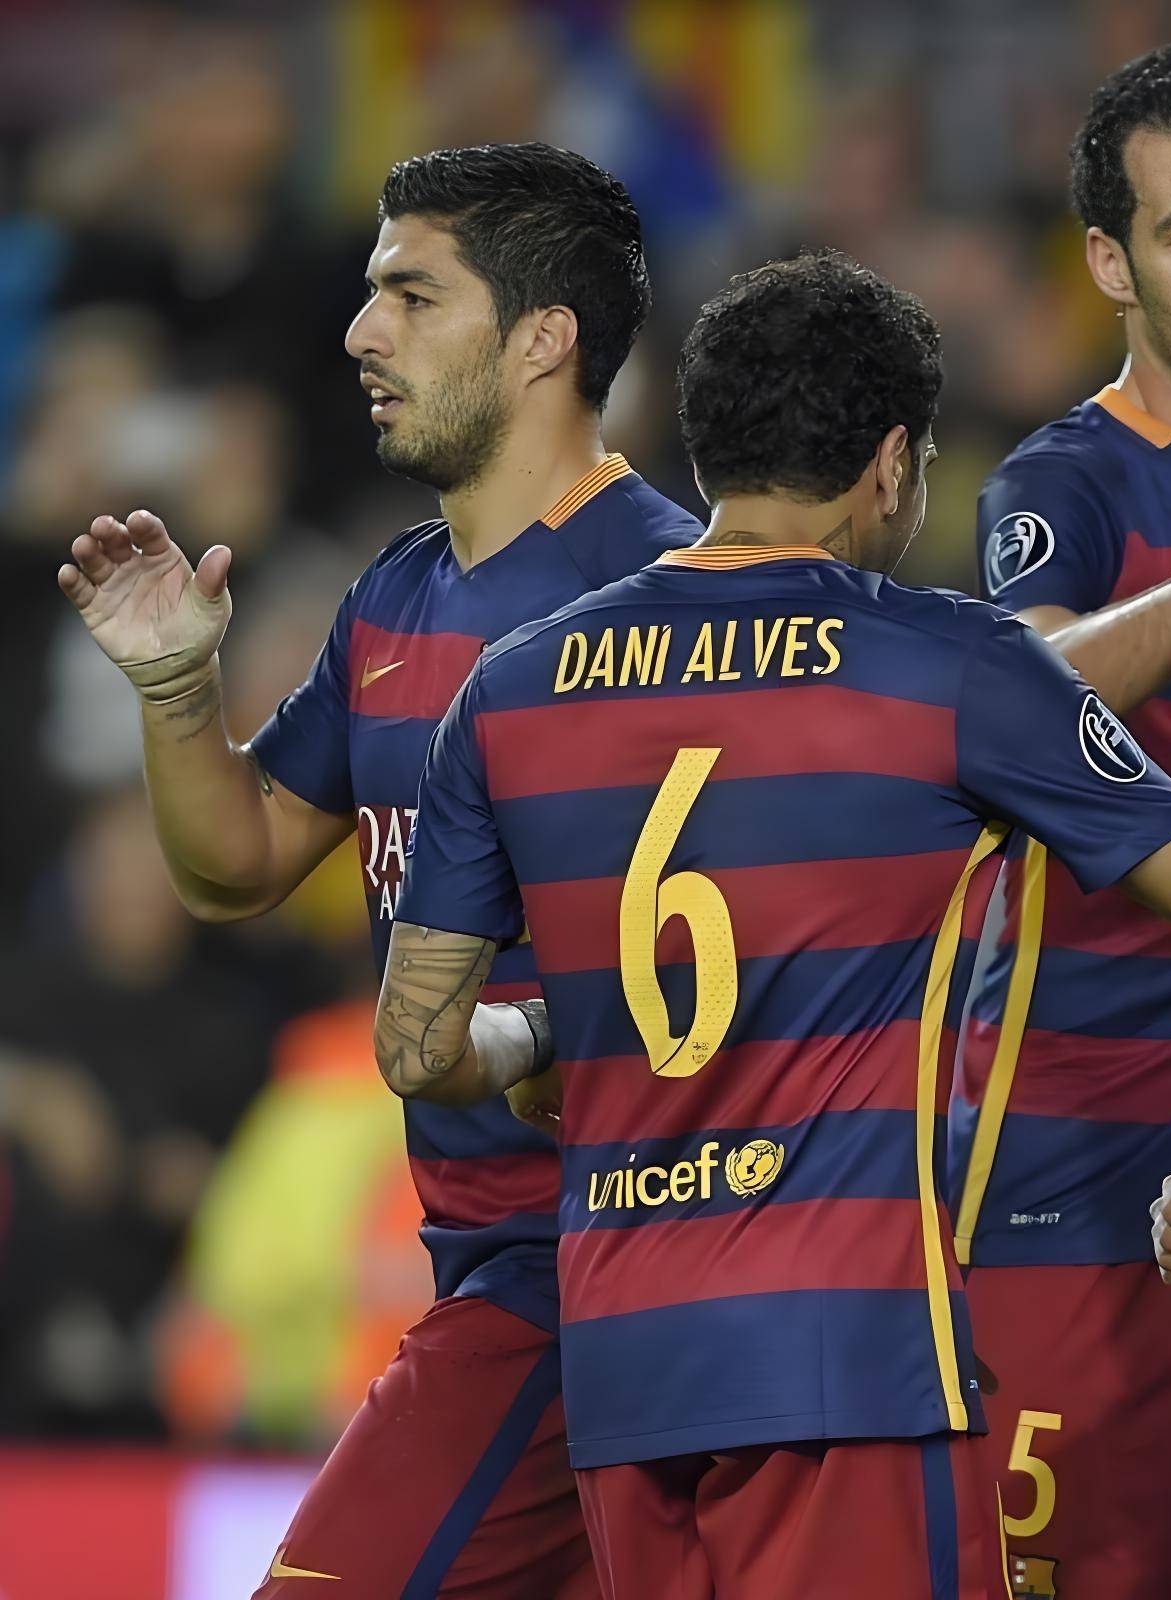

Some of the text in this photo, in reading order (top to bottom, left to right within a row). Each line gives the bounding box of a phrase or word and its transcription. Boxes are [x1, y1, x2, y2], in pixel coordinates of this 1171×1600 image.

[554, 617, 845, 694] DANI ALVES
[620, 748, 738, 1078] 6
[588, 1141, 719, 1212] unicef
[1004, 1410, 1062, 1537] 5
